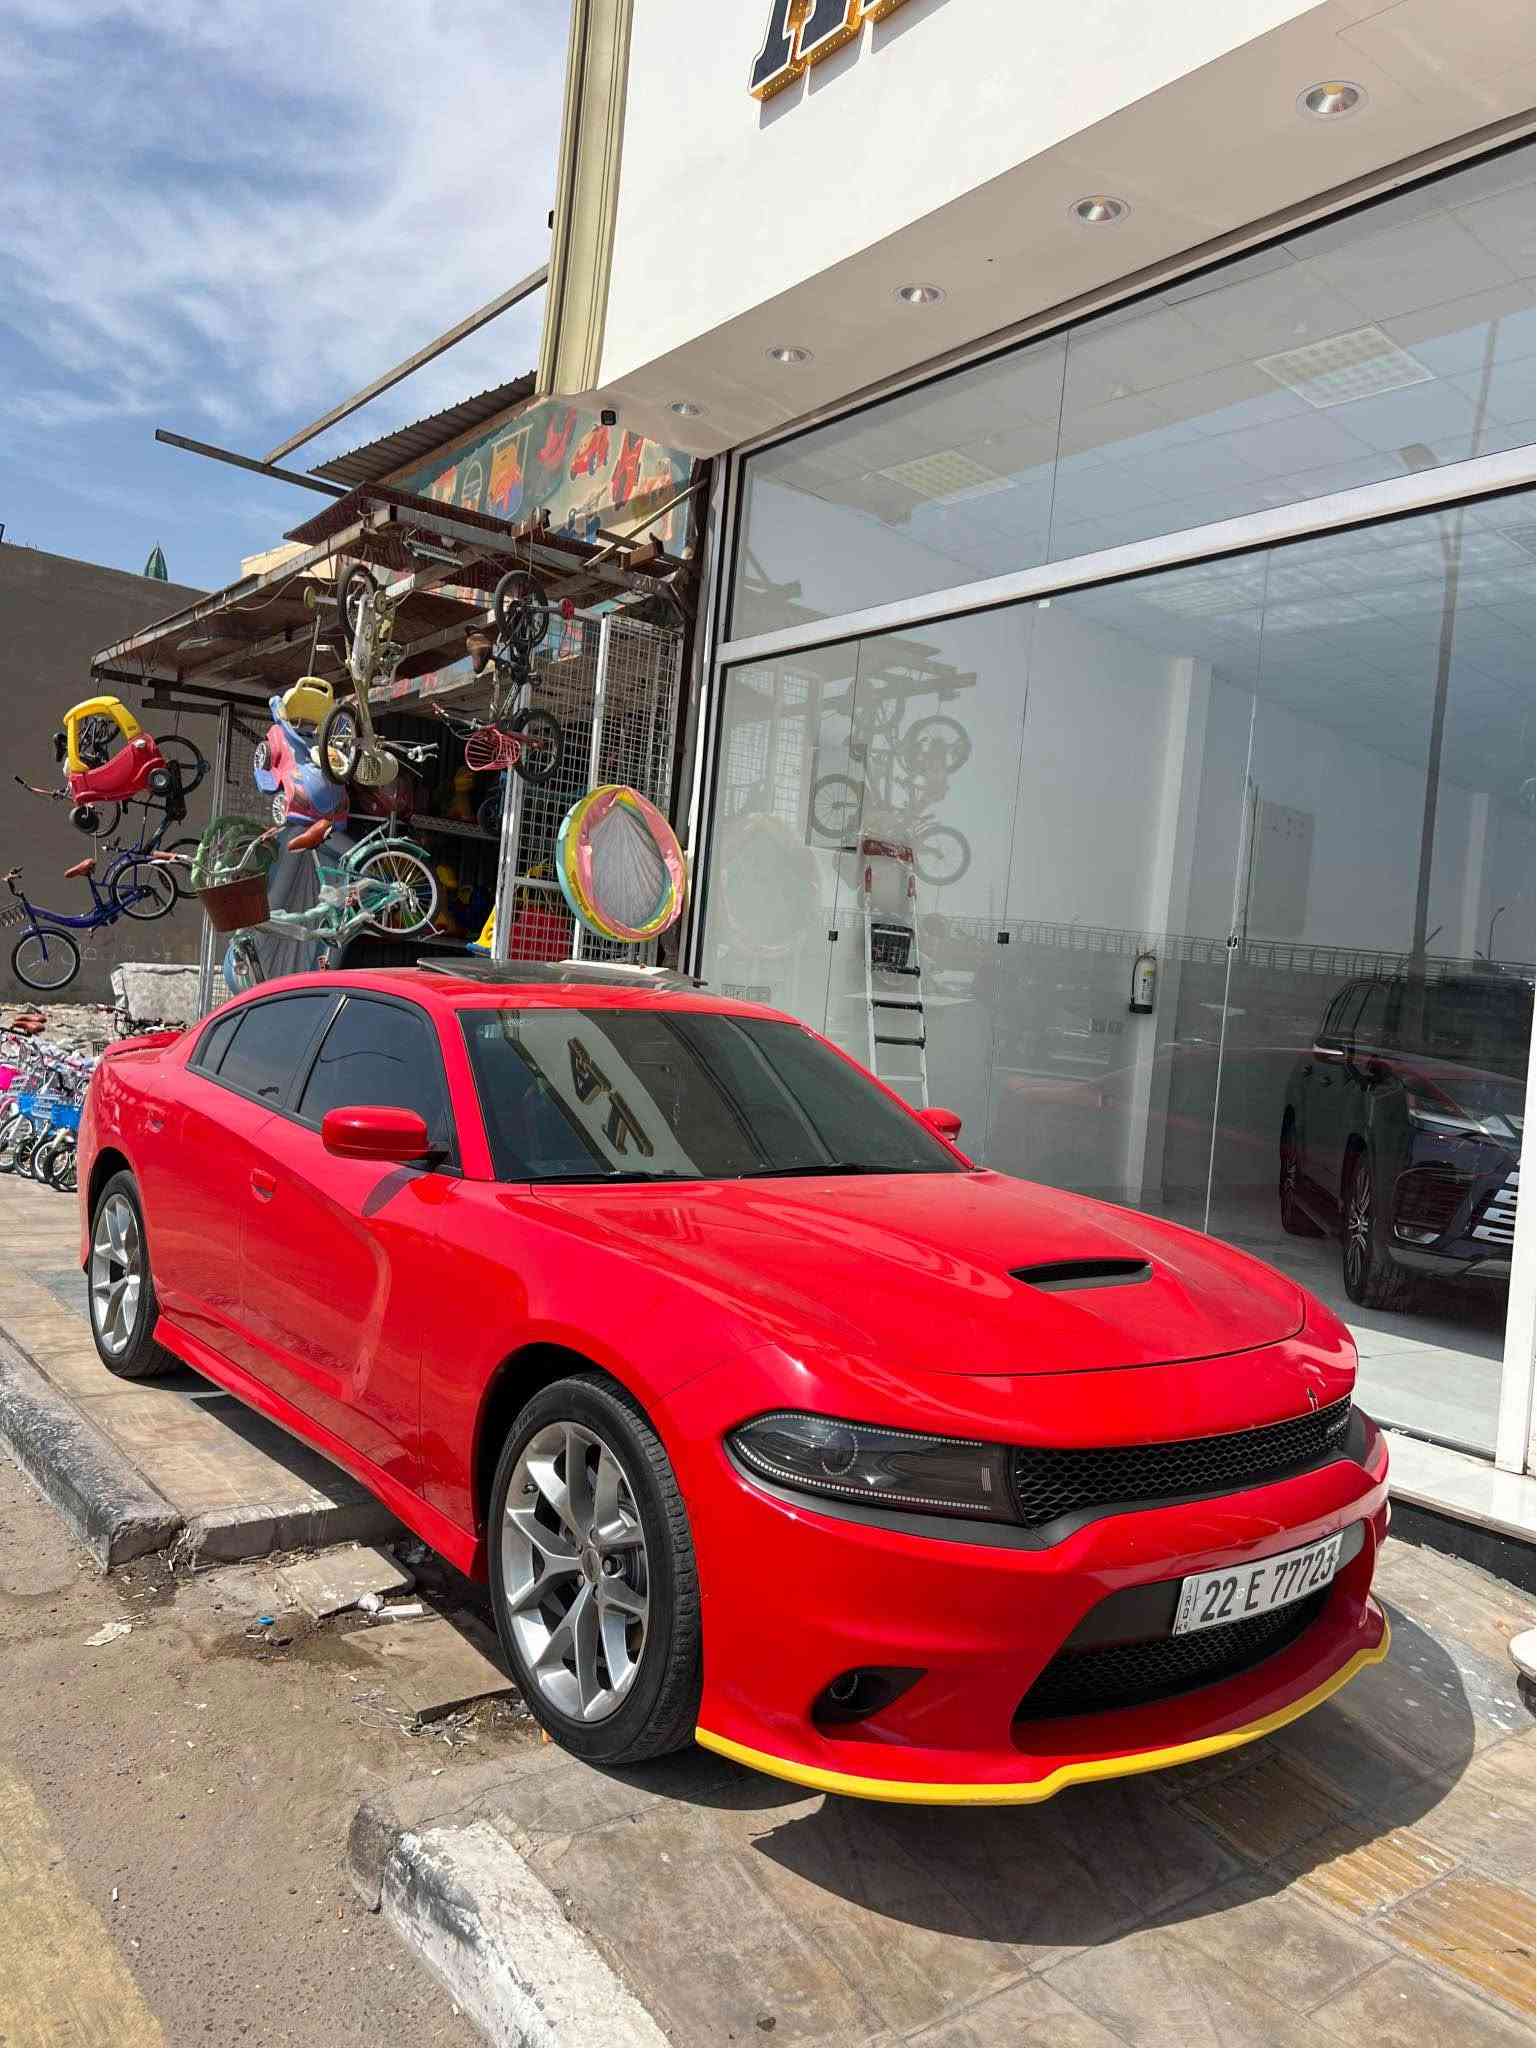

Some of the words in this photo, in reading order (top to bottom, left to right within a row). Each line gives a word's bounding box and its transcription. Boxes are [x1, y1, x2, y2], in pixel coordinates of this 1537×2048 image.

[1200, 1576, 1238, 1622] 22
[1244, 1569, 1265, 1611] E
[1270, 1540, 1338, 1603] 77723
